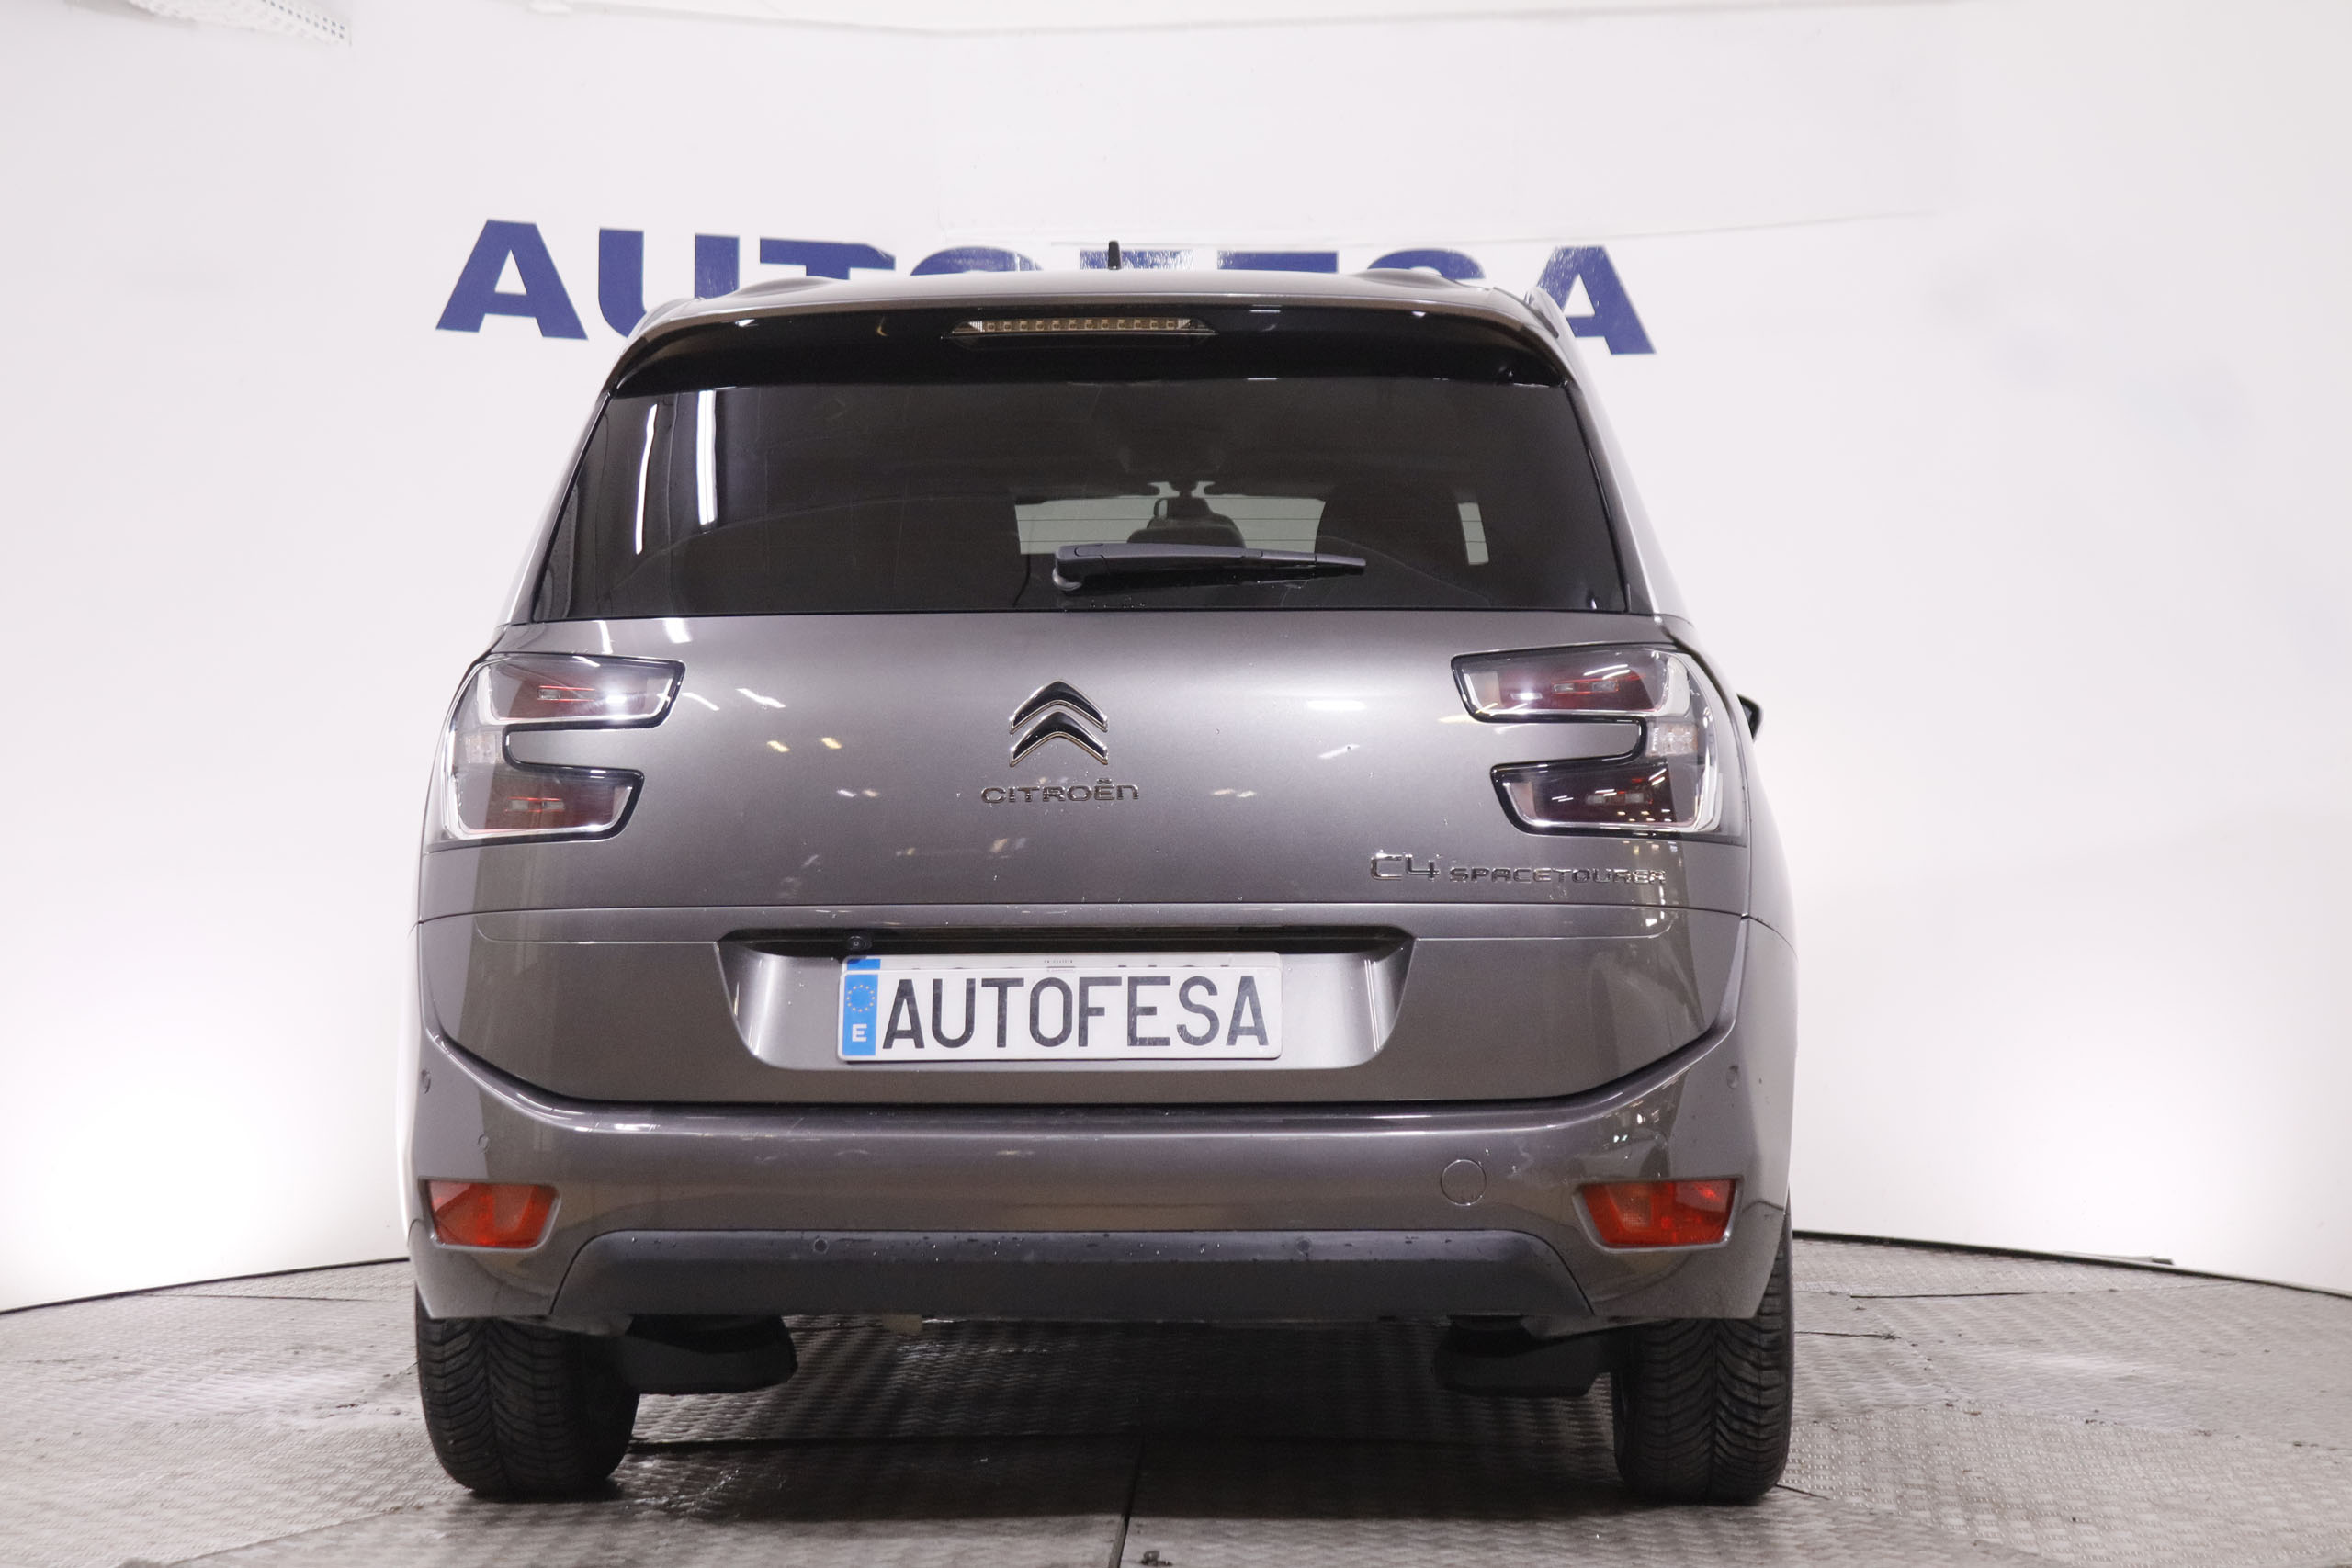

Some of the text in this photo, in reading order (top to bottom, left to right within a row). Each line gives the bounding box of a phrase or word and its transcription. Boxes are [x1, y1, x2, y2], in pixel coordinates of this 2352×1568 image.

[1370, 851, 1668, 886] C4 SPACETOURER
[851, 975, 1270, 1050] E AUTOFESA
